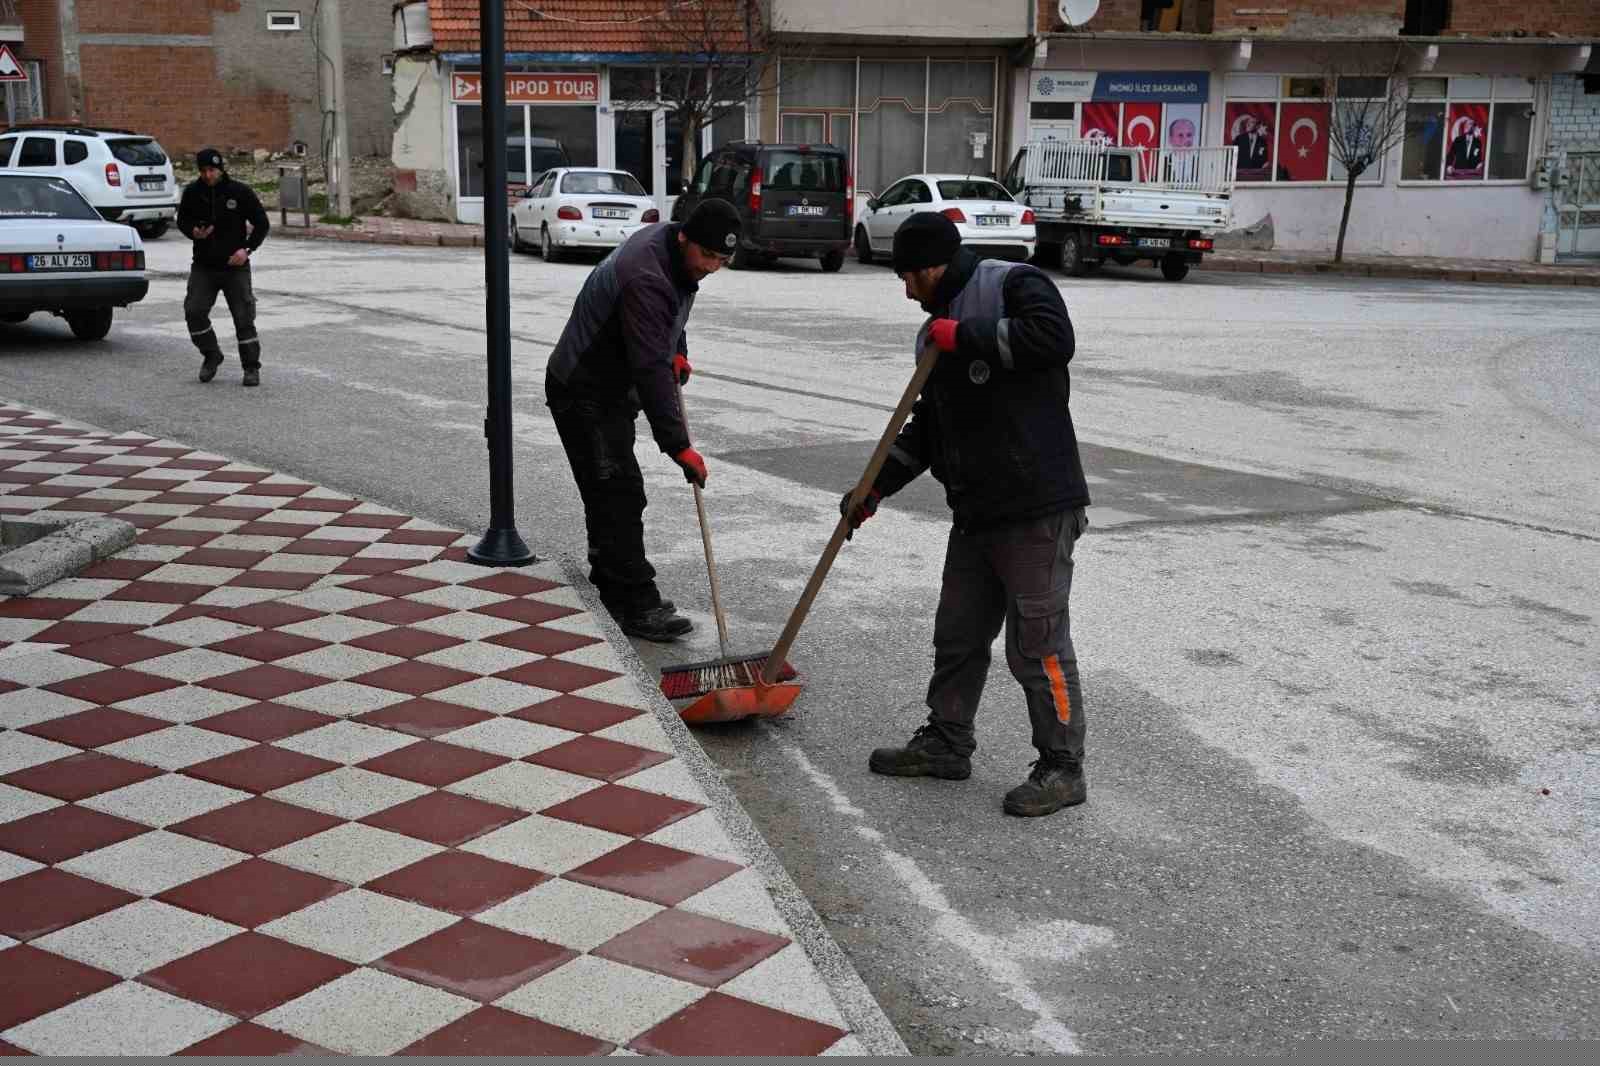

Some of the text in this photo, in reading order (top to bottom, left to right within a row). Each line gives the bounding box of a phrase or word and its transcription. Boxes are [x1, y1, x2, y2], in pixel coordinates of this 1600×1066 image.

[555, 80, 595, 95] TOUR
[34, 254, 90, 267] 26 ALV 258
